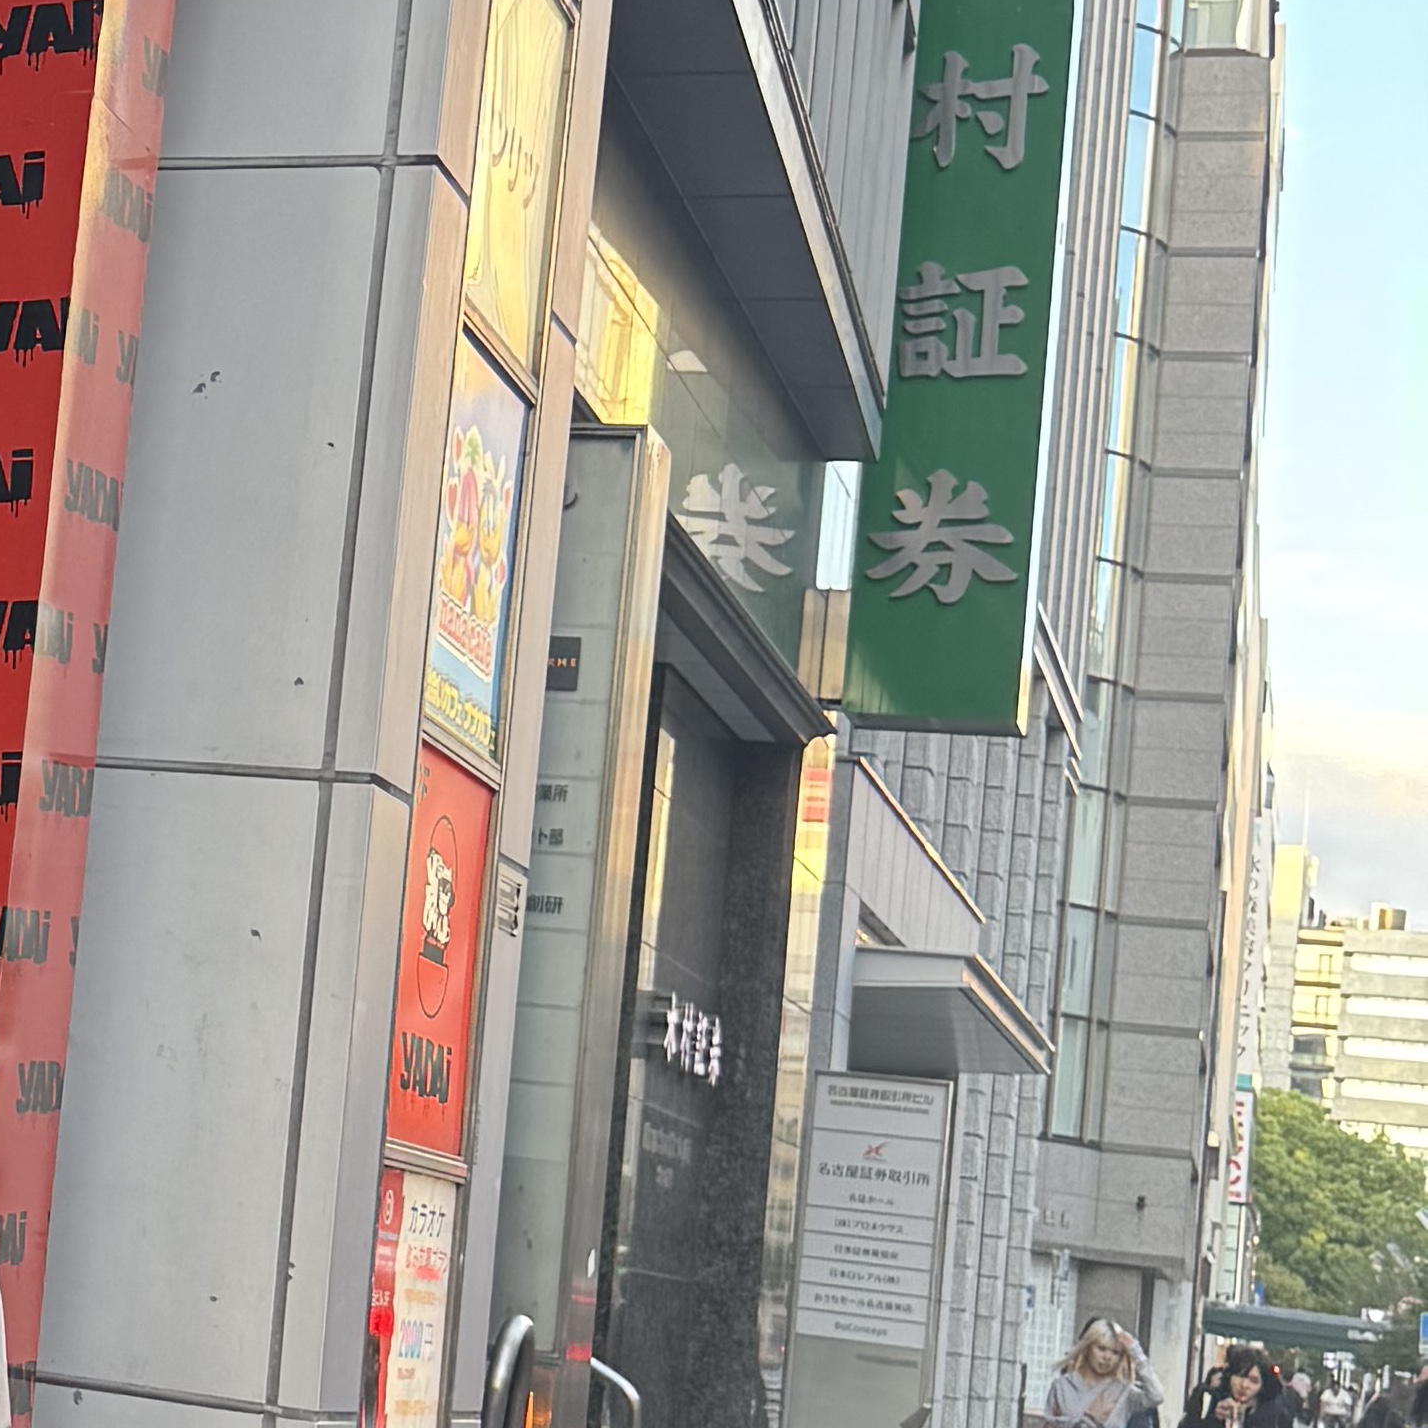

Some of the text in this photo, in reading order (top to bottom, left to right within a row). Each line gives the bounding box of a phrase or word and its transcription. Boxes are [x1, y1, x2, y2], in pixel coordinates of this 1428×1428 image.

[866, 43, 1050, 606] 村証券
[408, 1199, 447, 1238] カラオケ
